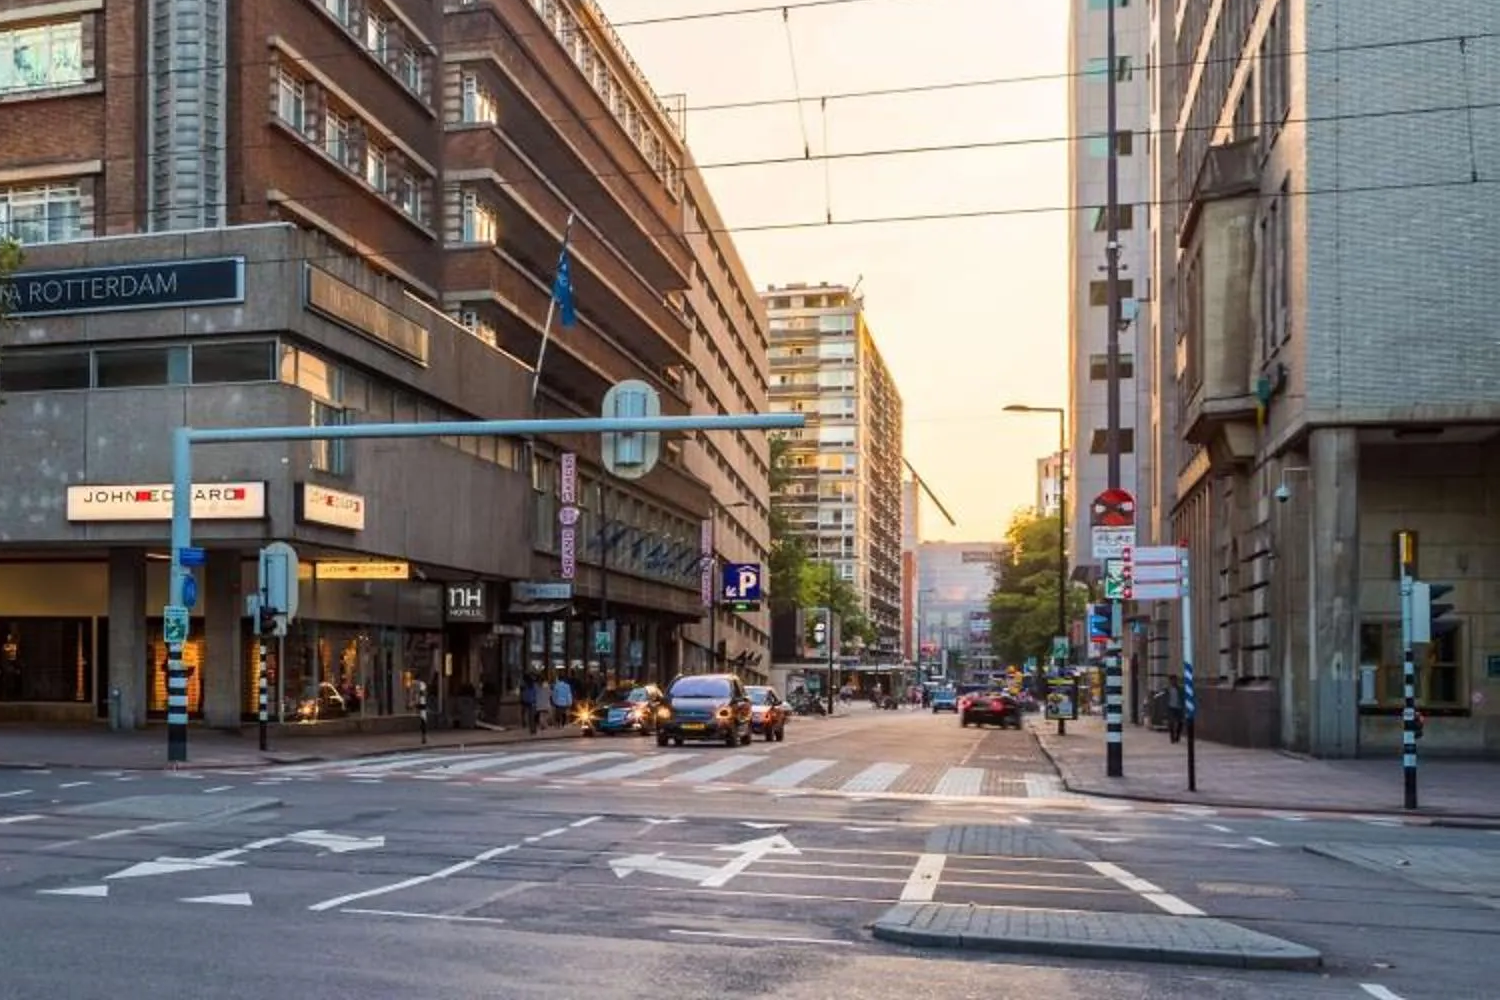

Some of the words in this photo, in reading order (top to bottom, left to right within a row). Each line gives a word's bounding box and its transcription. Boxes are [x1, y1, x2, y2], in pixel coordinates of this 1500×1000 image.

[29, 272, 177, 304] ROTTERDAM
[84, 491, 137, 503] JOHN
[149, 489, 237, 502] EDARD
[563, 531, 573, 577] GRAND
[739, 572, 757, 597] P
